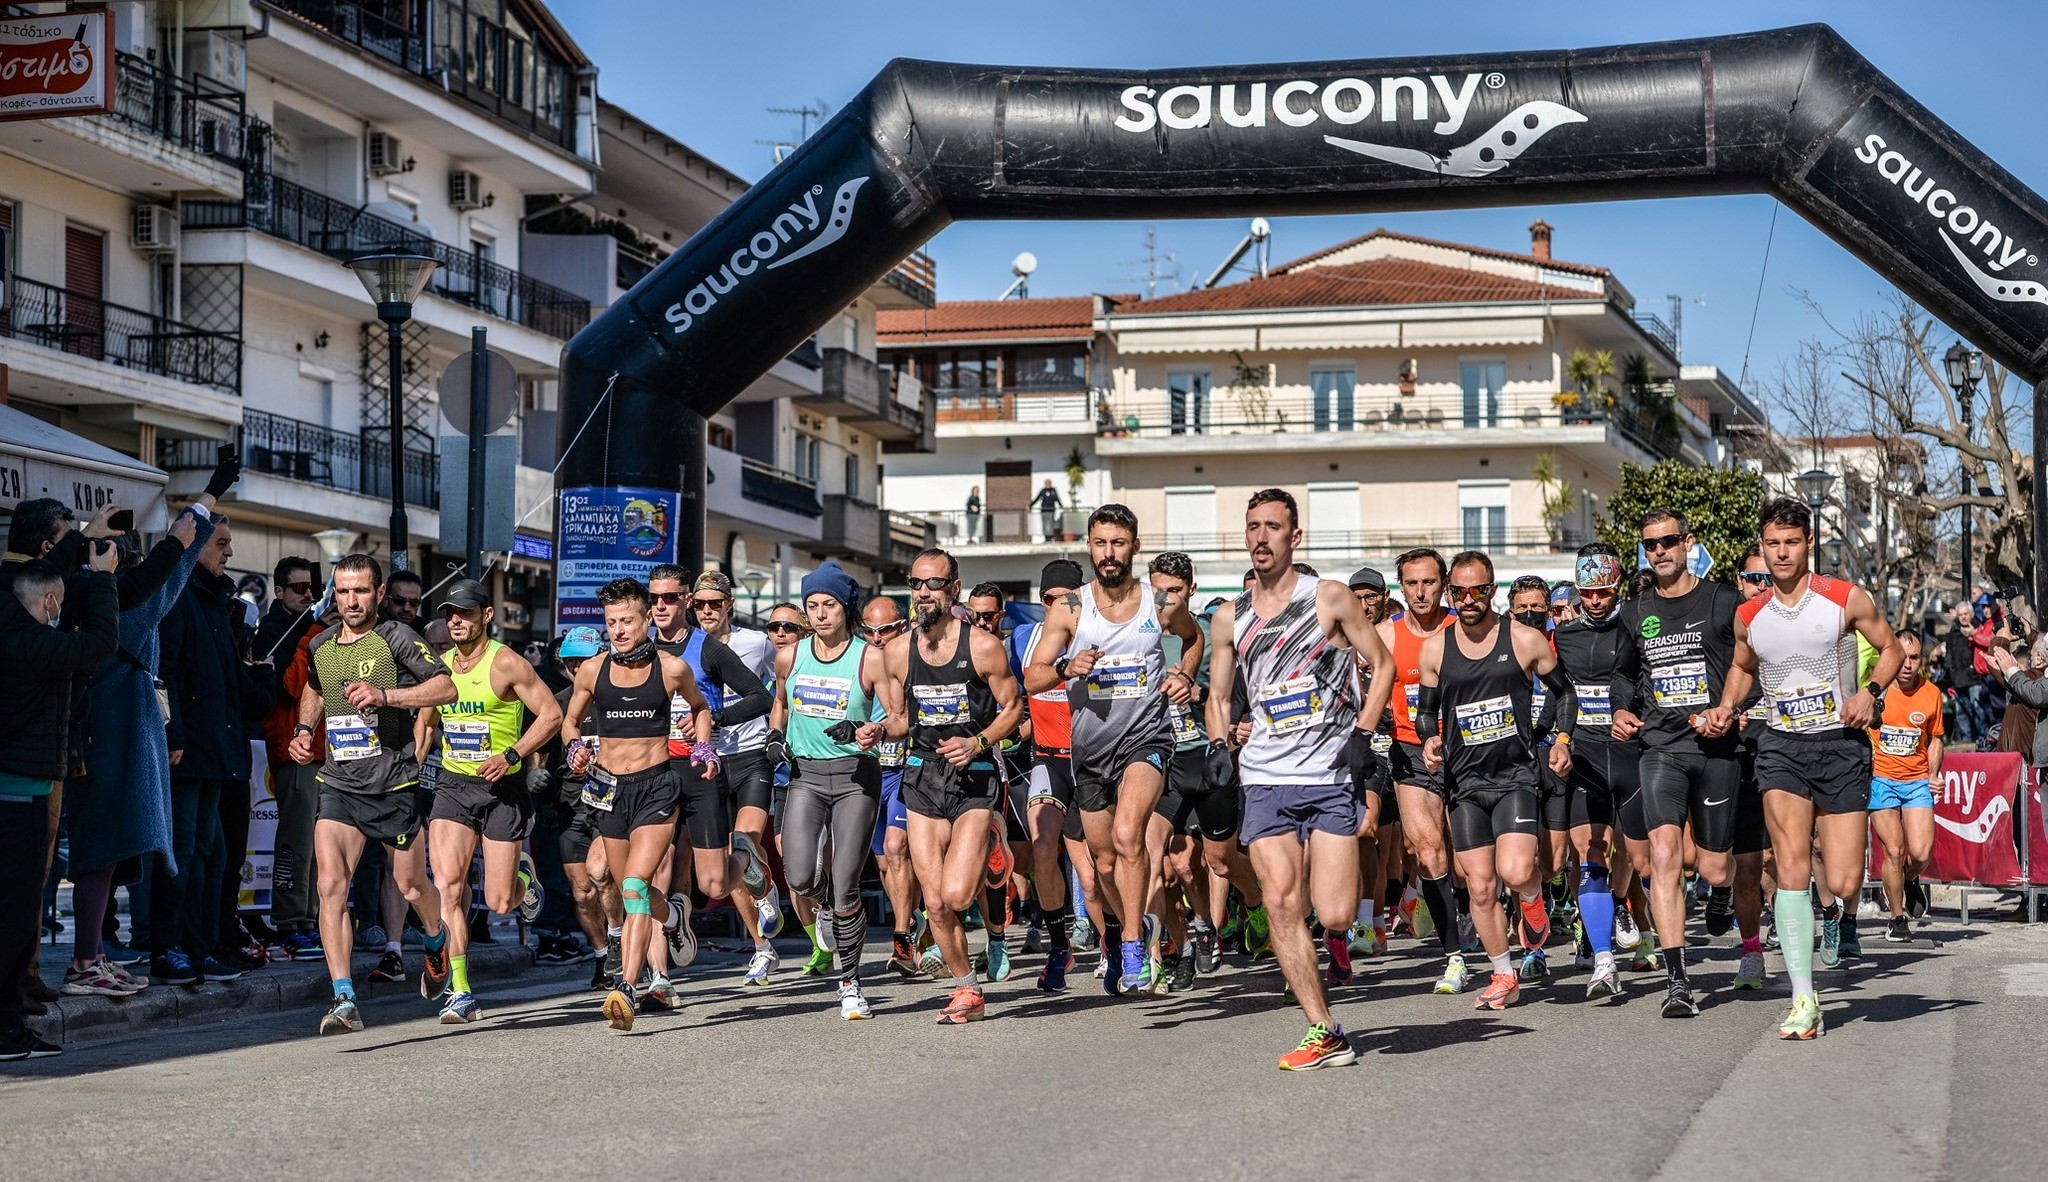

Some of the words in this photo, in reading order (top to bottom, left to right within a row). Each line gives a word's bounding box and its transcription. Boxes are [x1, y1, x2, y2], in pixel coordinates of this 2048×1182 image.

[0, 24, 62, 38] ιτάδικο
[0, 466, 21, 499] ΣΑ
[565, 512, 619, 524] ΚΑΛΑΜΠΑΚΑ
[575, 562, 618, 571] ΠΕΡΙΦΕΡΕΙΑ
[621, 563, 653, 572] ΘΕΣΣΑΛ
[592, 606, 605, 615] ΜΟΝ
[1644, 631, 1703, 650] KERASOVITIS
[1661, 677, 1696, 692] 21395
[1269, 699, 1307, 714] STAMOULIS
[1785, 696, 1824, 716] 22054
[606, 709, 657, 719] saucony
[1468, 711, 1504, 730] 22687
[1171, 717, 1184, 729] 15
[1887, 734, 1913, 745] 22078
